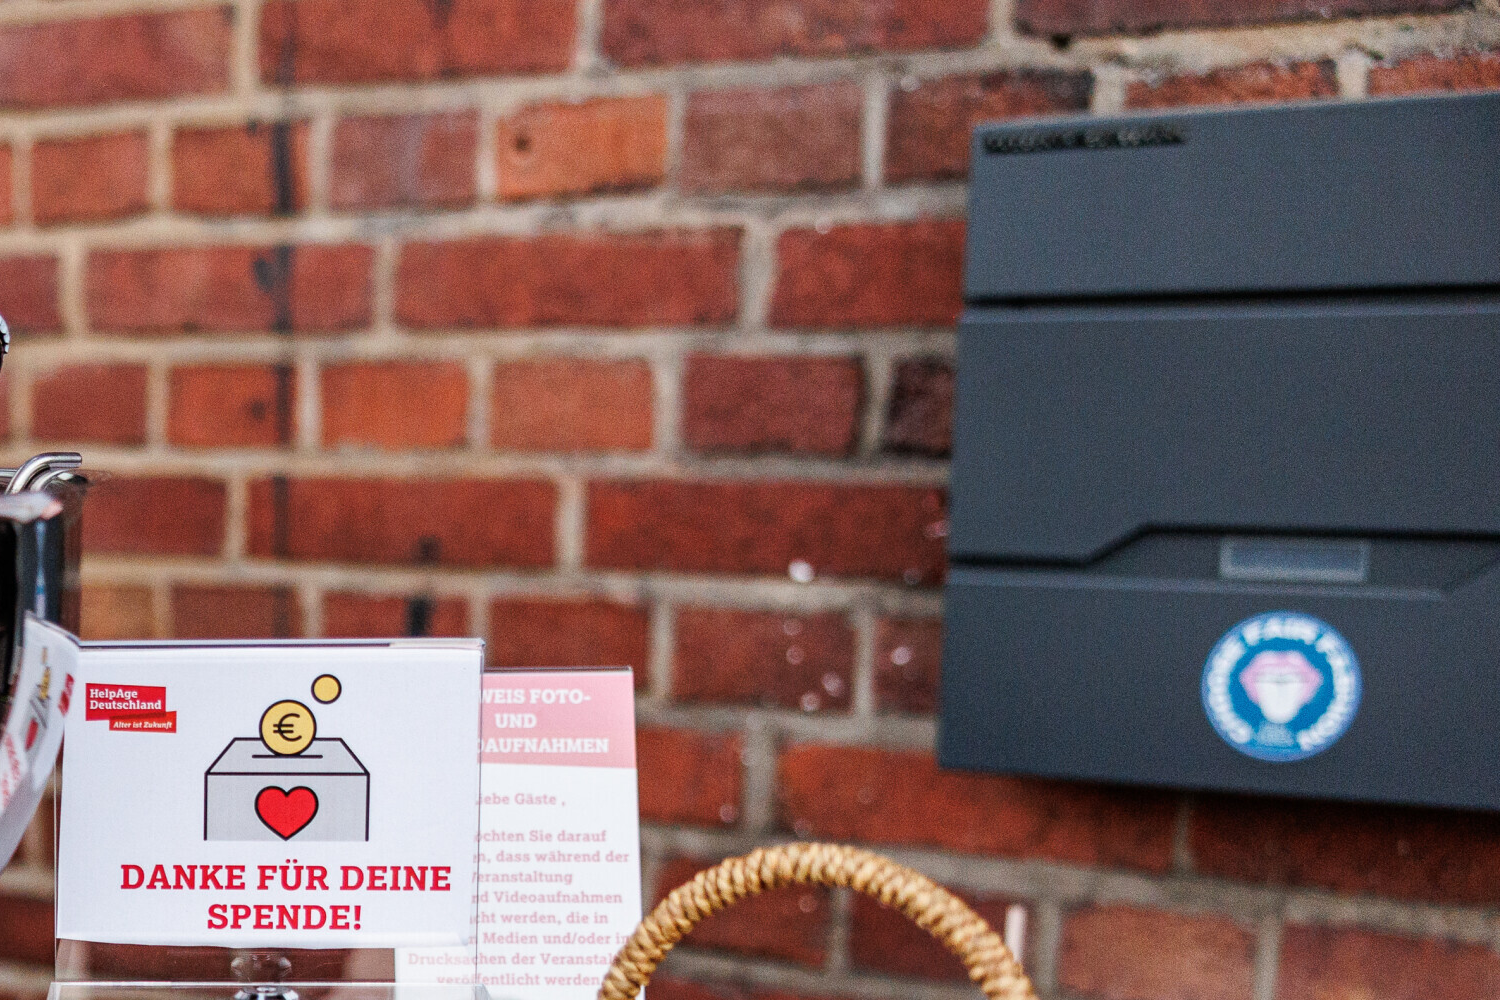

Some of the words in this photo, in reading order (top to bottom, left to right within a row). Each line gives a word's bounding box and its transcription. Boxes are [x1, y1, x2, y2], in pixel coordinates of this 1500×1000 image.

[89, 688, 138, 700] HelpAge
[479, 687, 527, 705] WEIS
[529, 687, 592, 705] FOTO-
[89, 699, 162, 710] Deutschland
[113, 721, 131, 729] Alter
[132, 721, 143, 729] ist
[143, 721, 173, 730] Zukunft
[494, 712, 538, 729] UND
[478, 737, 610, 753] AUFNAHMEN
[529, 829, 553, 842] Sie
[557, 829, 607, 842] darauf
[496, 850, 531, 863] dass
[534, 850, 601, 863] während
[605, 850, 629, 863] der
[120, 863, 246, 890] DANKE
[257, 859, 329, 891] FÜR
[339, 865, 452, 892] DEINE
[494, 890, 623, 904] Videoaufnahmen
[207, 903, 362, 931] SPENDE!
[500, 911, 562, 926] werden,
[566, 911, 589, 924] die
[593, 911, 609, 924] in
[483, 932, 538, 945] Medien
[542, 931, 612, 945] und/oder
[408, 952, 507, 966] Drucksachen
[511, 952, 535, 966] der
[436, 973, 540, 986] veröffentlicht
